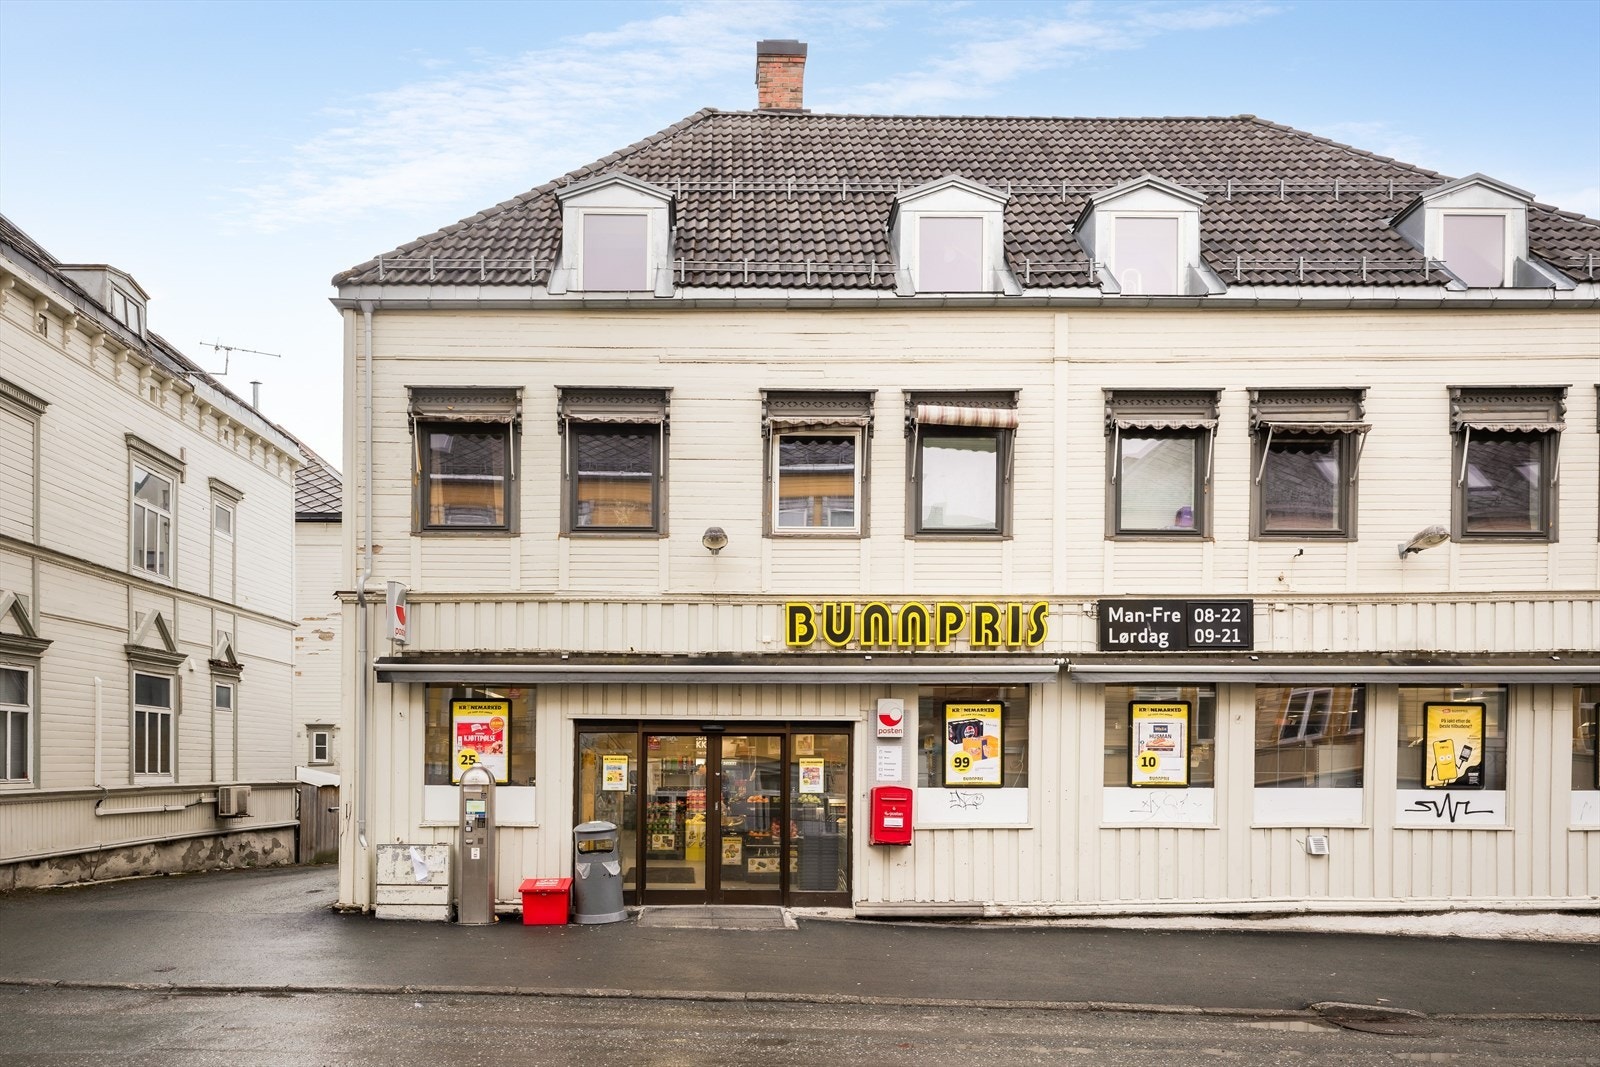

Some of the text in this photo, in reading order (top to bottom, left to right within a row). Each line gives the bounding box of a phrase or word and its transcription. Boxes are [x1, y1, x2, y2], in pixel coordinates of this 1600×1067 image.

[1108, 606, 1242, 623] Man-Fre 08-22
[785, 601, 1049, 647] BUNNPRIS
[1108, 627, 1241, 649] Lørdag 09-21
[460, 754, 476, 766] 25
[954, 756, 970, 768] 99
[1141, 756, 1156, 768] 10
